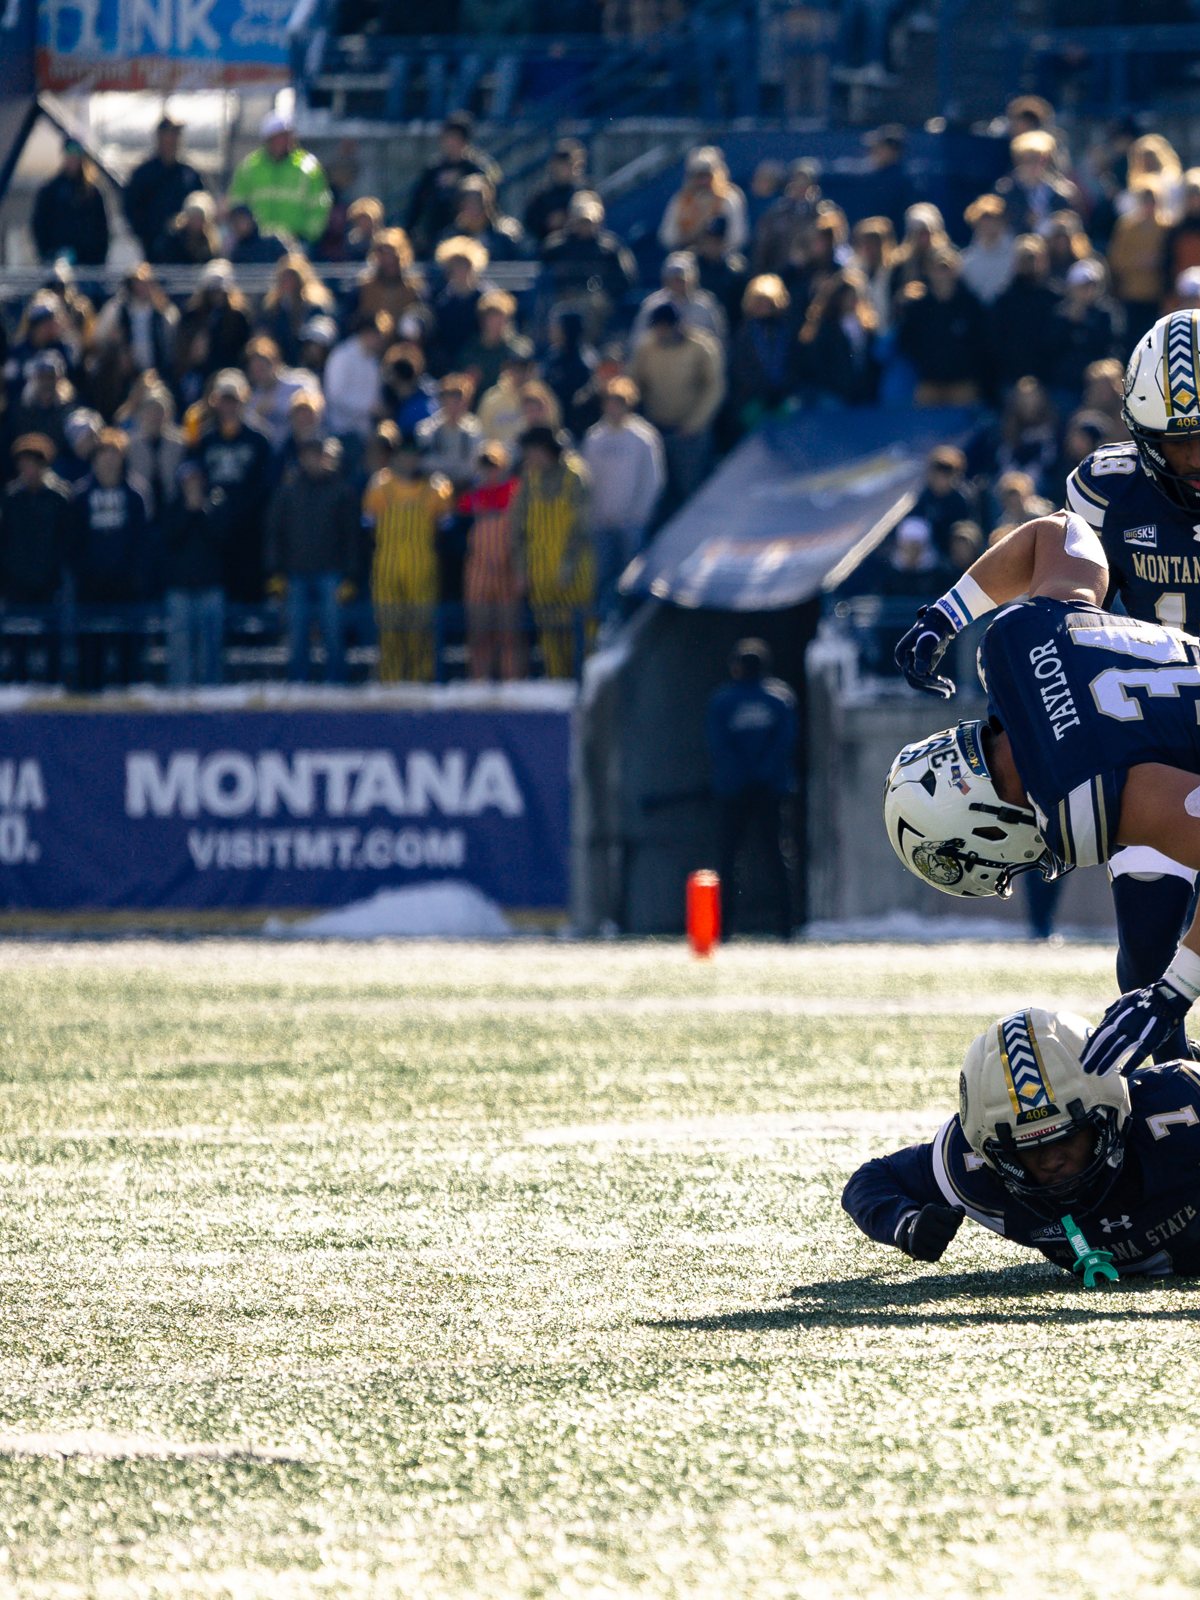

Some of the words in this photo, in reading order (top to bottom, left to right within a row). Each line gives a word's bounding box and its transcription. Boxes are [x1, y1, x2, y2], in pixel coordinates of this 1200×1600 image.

[1176, 417, 1198, 427] 406
[1028, 638, 1081, 741] TAYLOR
[124, 749, 526, 817] MONTANA
[186, 828, 466, 870] VISITMT.COM
[1026, 1106, 1049, 1121] 406
[1145, 1105, 1200, 1141] 1
[1145, 1204, 1197, 1247] STATE
